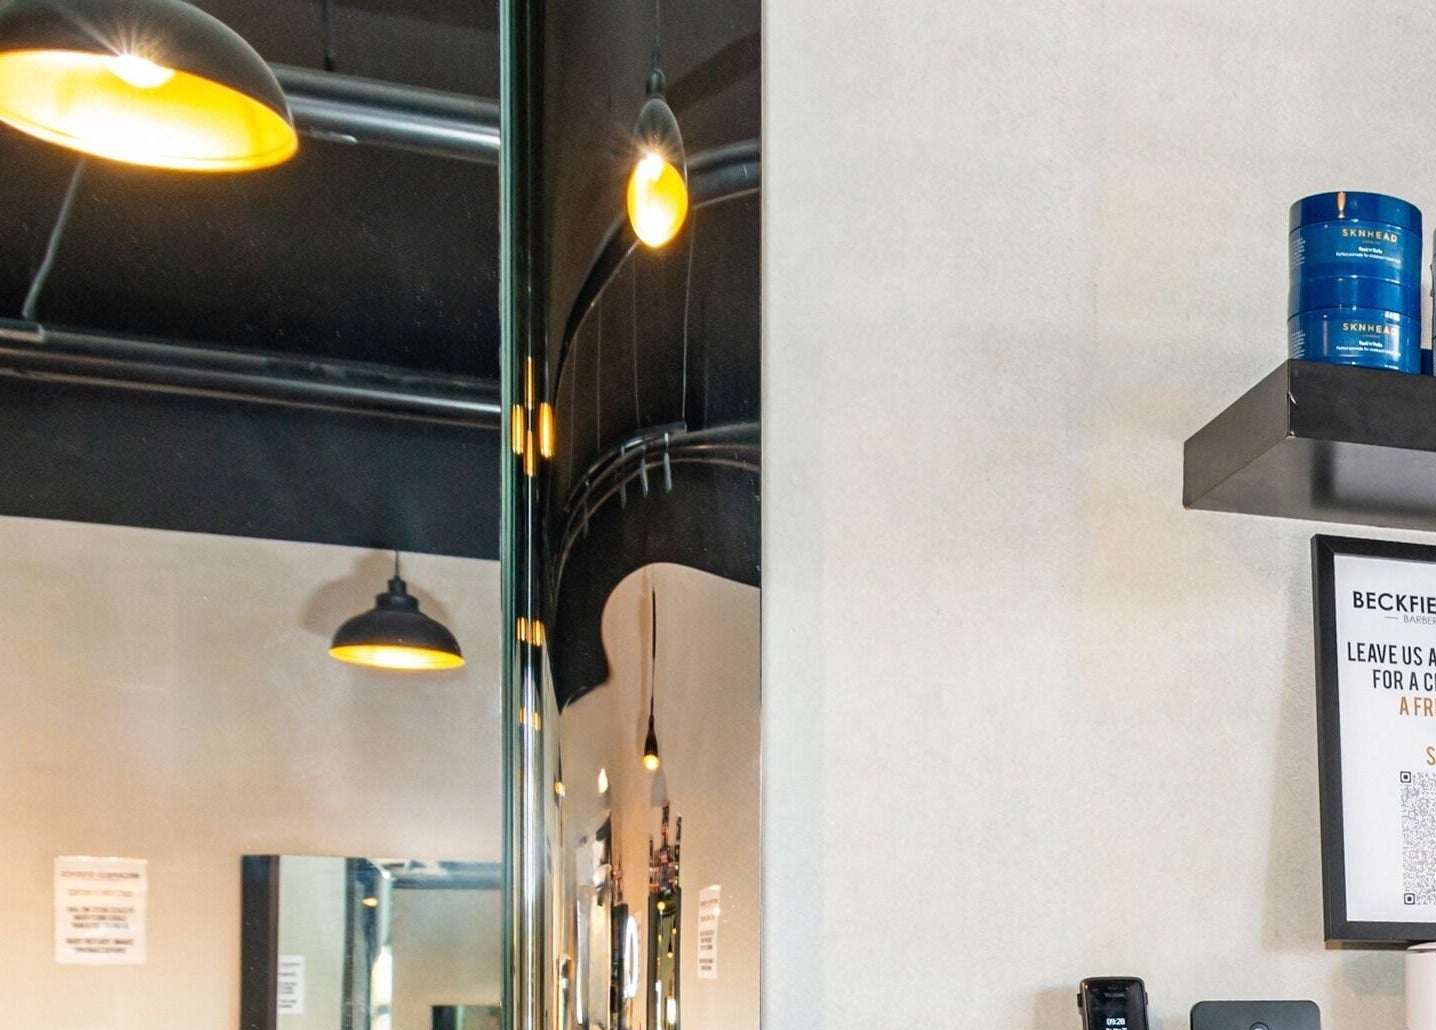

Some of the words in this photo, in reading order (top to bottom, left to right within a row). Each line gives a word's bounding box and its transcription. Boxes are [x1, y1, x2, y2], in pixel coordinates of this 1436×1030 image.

[1342, 228, 1398, 243] SKNHEAD
[1342, 322, 1397, 336] SKNHEAD
[1347, 641, 1397, 665] LEAVE
[1402, 646, 1423, 666] US
[1373, 669, 1403, 691] FOR
[1409, 672, 1419, 692] A
[1399, 696, 1409, 715] A
